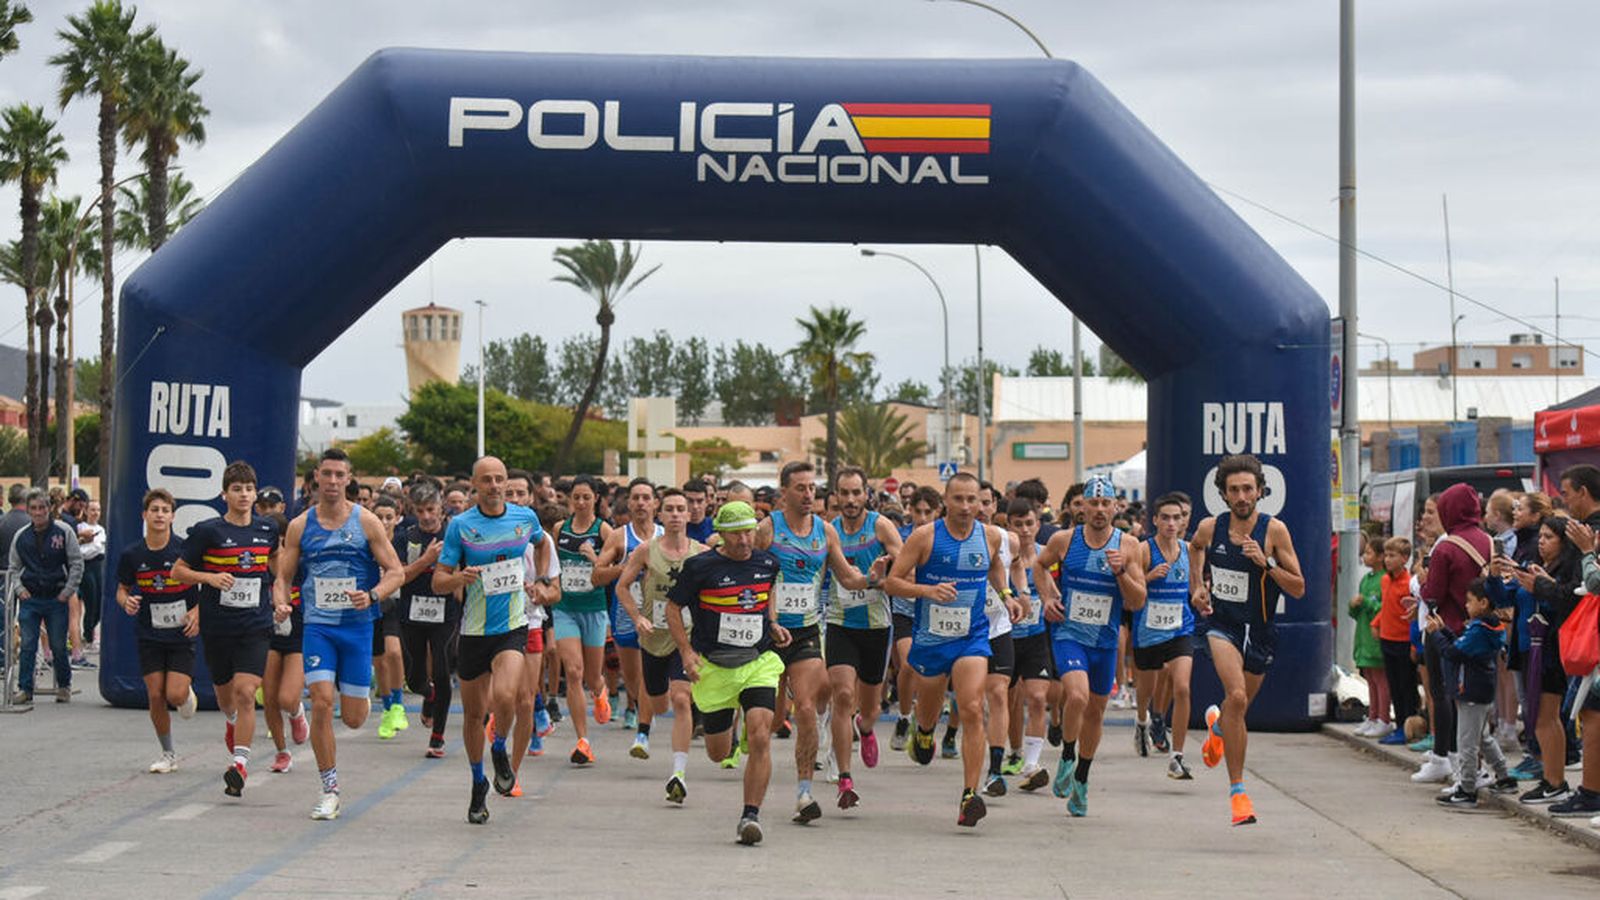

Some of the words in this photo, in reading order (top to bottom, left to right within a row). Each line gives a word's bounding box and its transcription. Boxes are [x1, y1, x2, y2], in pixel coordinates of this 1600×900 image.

[697, 153, 990, 185] NACIONAL
[148, 380, 231, 439] RUTA
[1203, 401, 1287, 455] RUTA
[492, 574, 519, 589] 372
[849, 590, 866, 601] 70
[1215, 583, 1239, 596] 430
[230, 591, 253, 602] 391
[323, 593, 348, 603] 225
[784, 596, 808, 608] 215
[163, 614, 177, 623] 61
[1079, 607, 1102, 619] 284
[939, 620, 962, 631] 193
[1153, 615, 1176, 625] 315
[728, 629, 754, 641] 316
